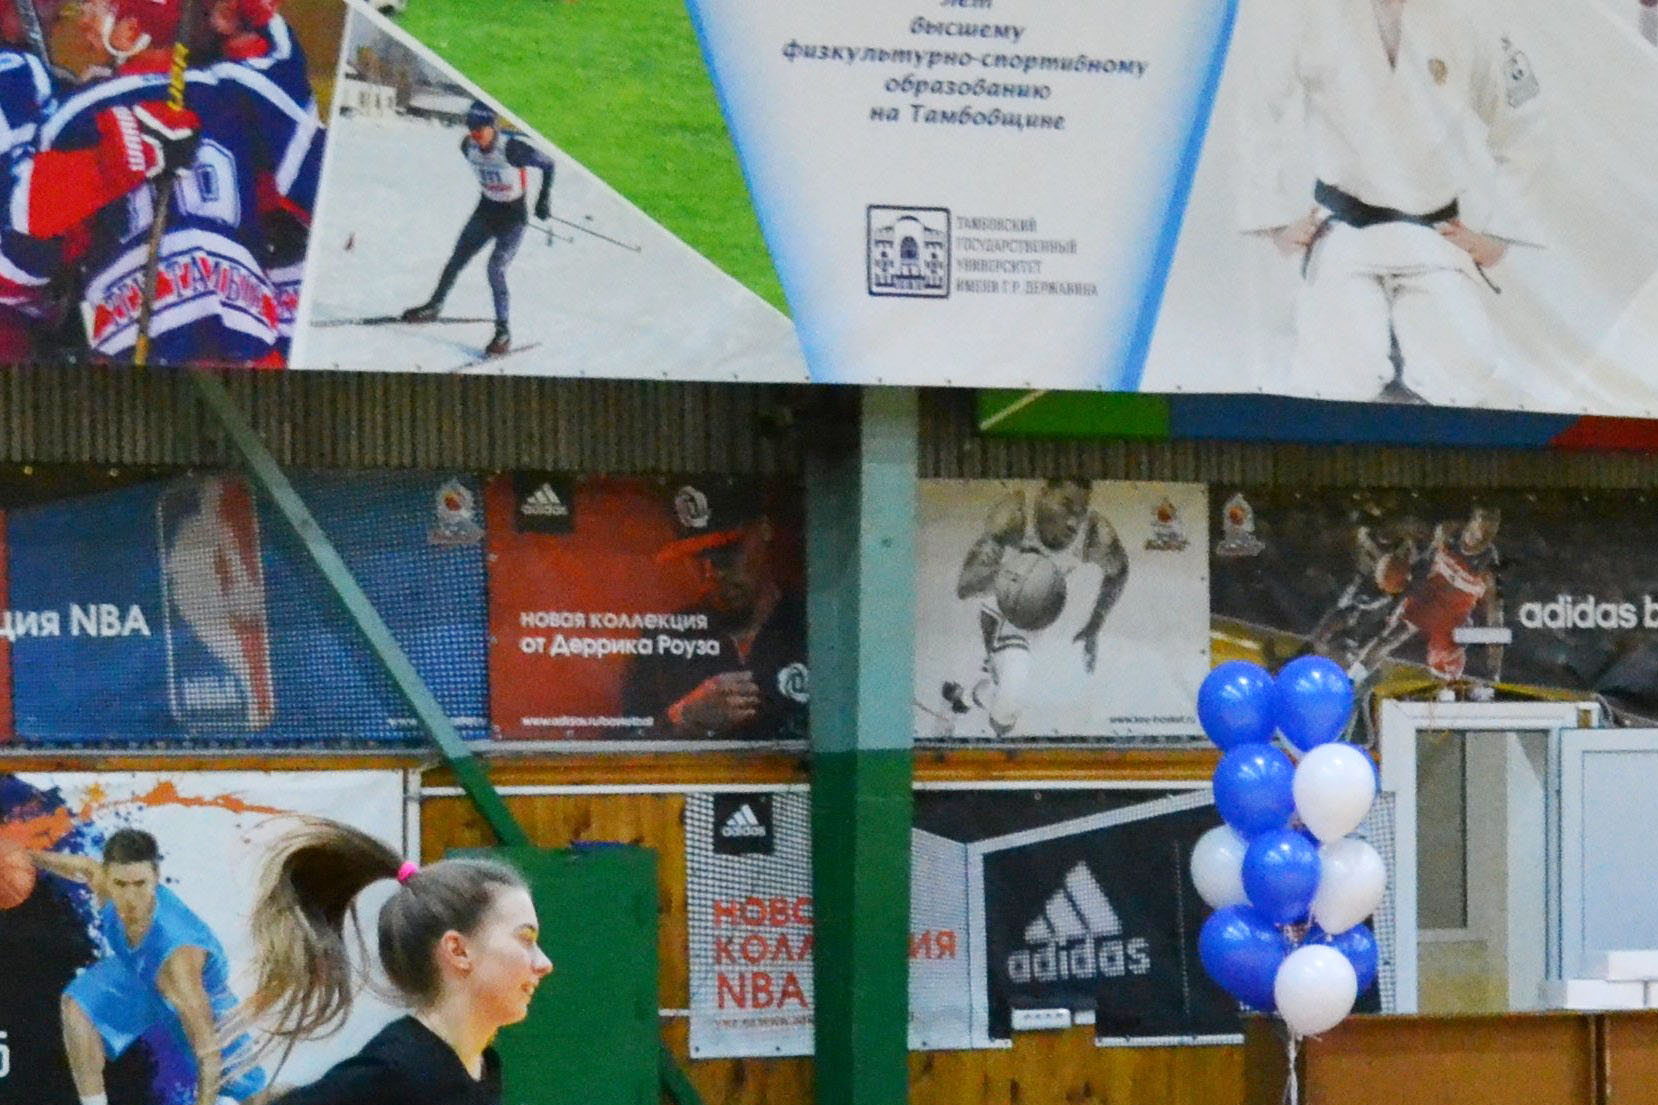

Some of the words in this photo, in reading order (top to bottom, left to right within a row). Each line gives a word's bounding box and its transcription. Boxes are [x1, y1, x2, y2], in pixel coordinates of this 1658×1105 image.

[909, 16, 1026, 42] высшему
[782, 38, 1149, 78] физкультурно-спортивному
[885, 73, 1052, 100] образованию
[869, 106, 900, 123] на
[910, 104, 1066, 130] Тамбовщине
[69, 603, 151, 637] NBA
[1517, 594, 1638, 629] adidas
[519, 636, 546, 654] от
[550, 634, 652, 658] Деррика
[656, 634, 720, 660] Роуза
[1007, 936, 1151, 984] adidas
[716, 971, 809, 1010] NBA
